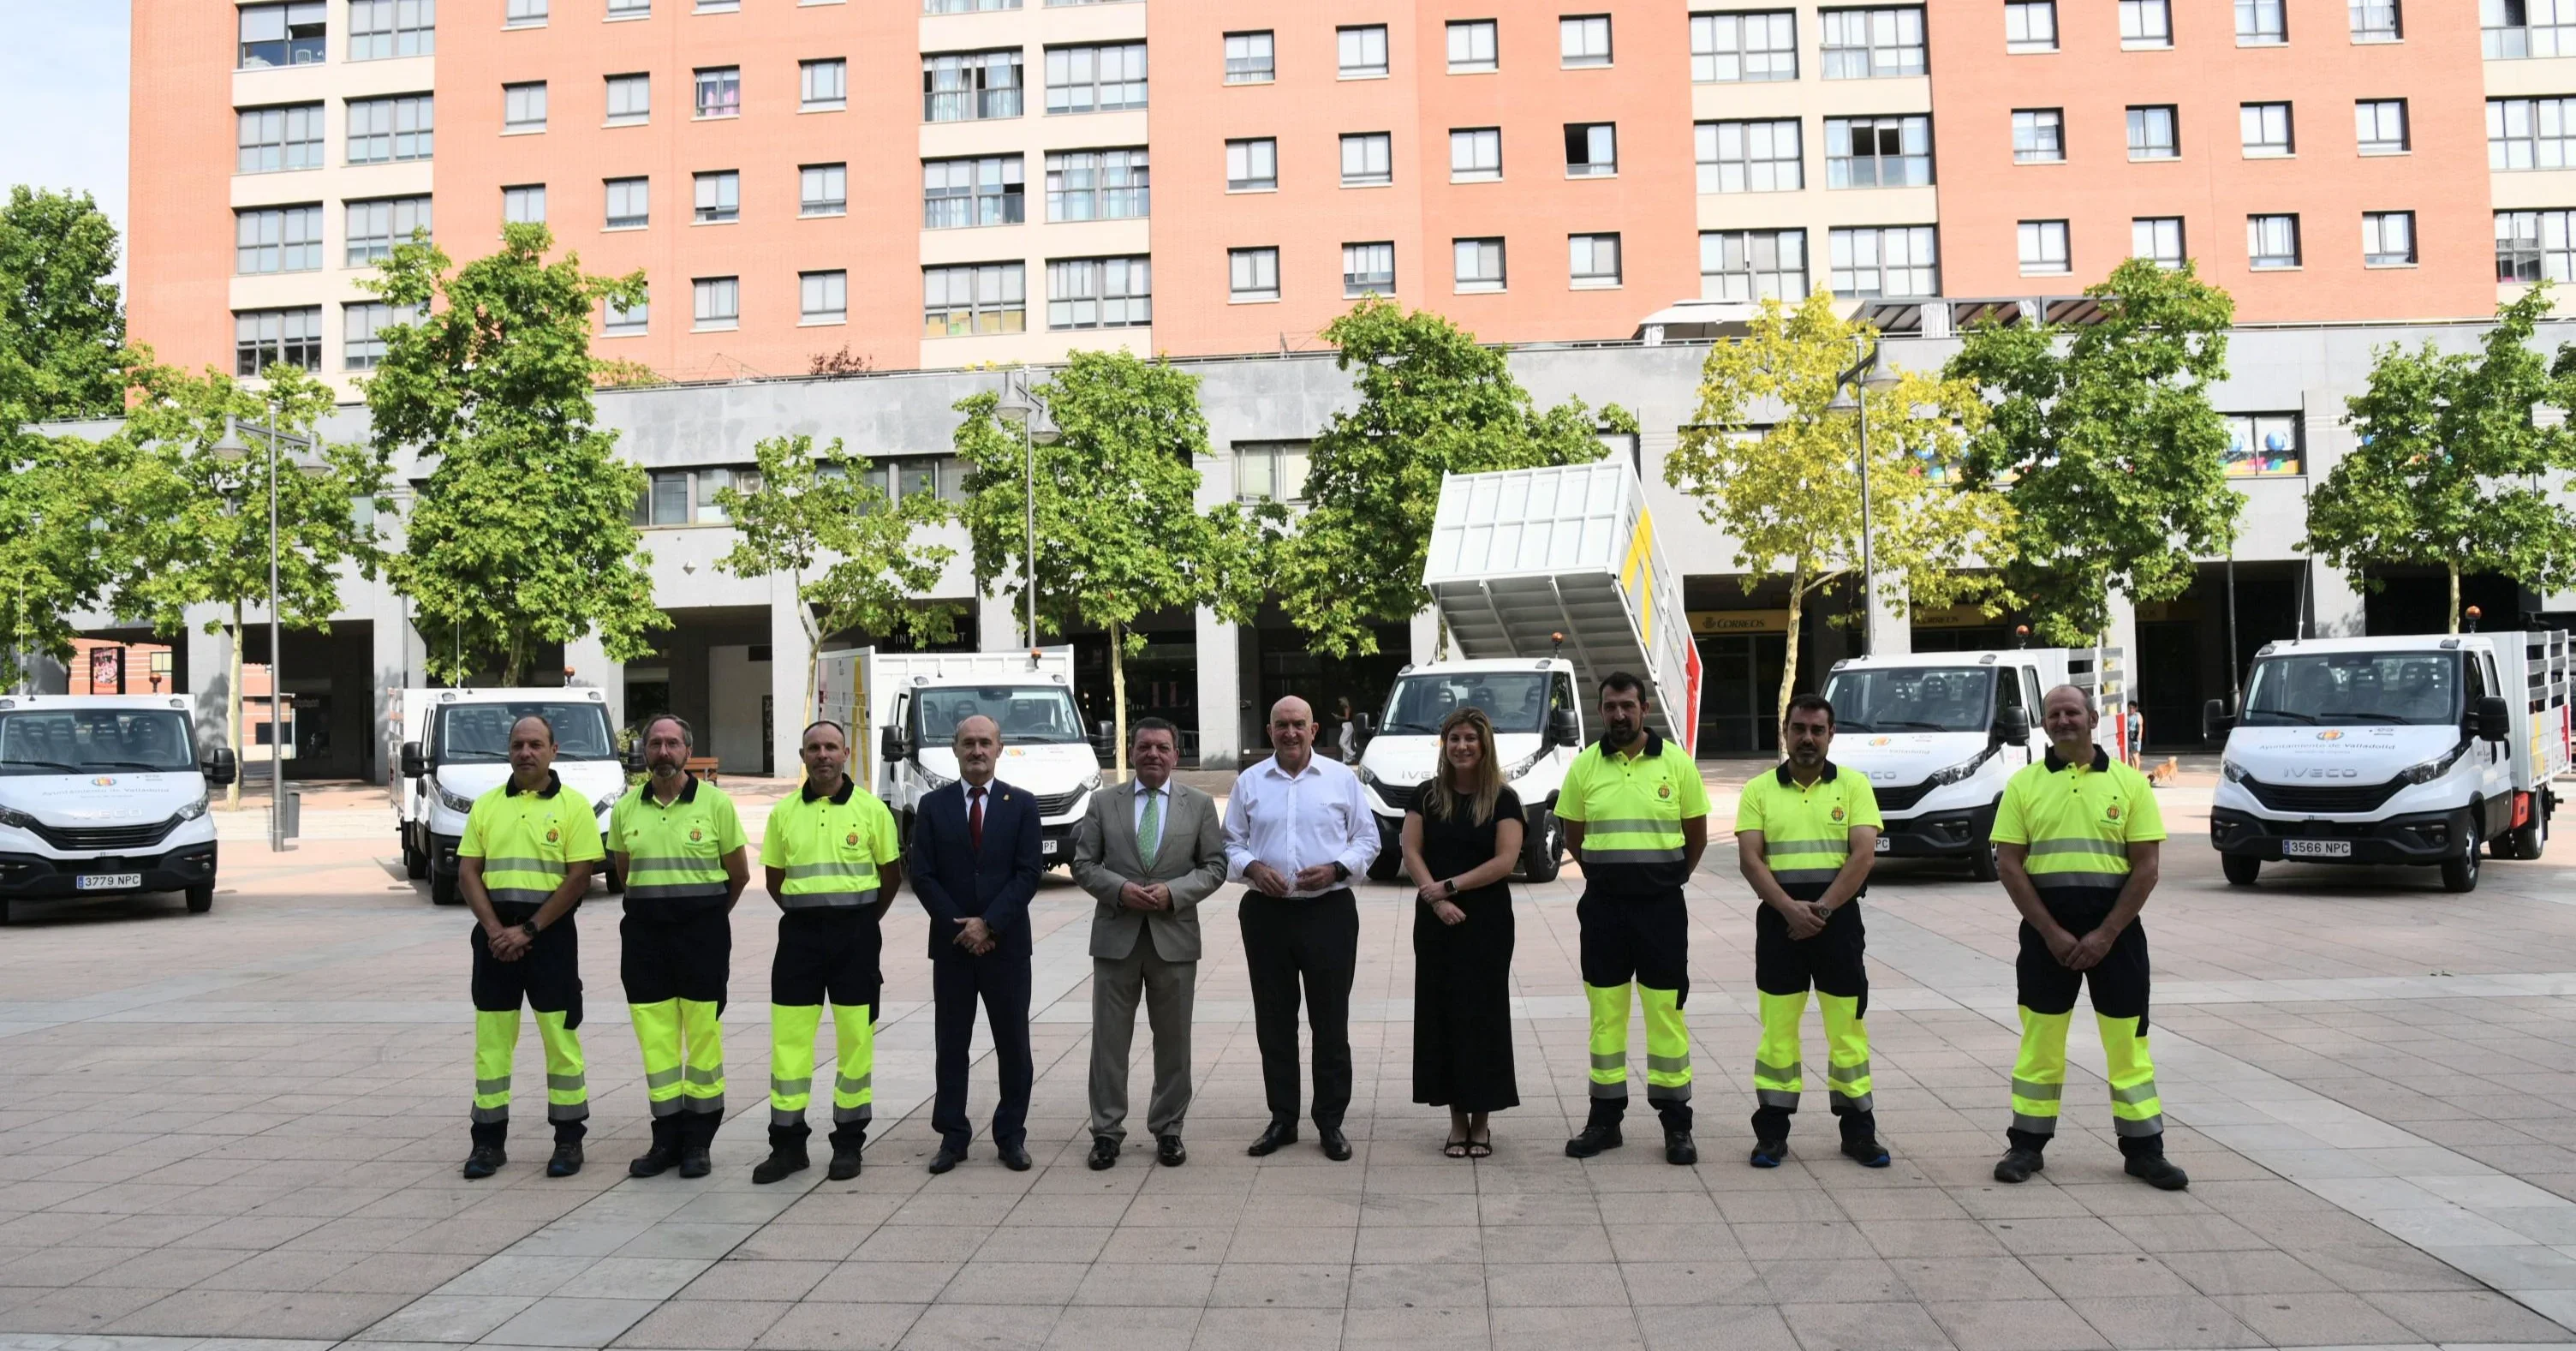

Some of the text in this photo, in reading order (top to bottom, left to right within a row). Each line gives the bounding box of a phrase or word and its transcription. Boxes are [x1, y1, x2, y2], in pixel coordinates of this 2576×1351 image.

[1717, 619, 1765, 628] CORREOS
[1401, 770, 1436, 780] IVE
[2283, 768, 2358, 778] IVECO
[1044, 841, 1056, 851] PF
[1875, 839, 1888, 849] PC
[2292, 842, 2349, 854] 3566 NPC
[85, 875, 140, 887] 3779 NPC
